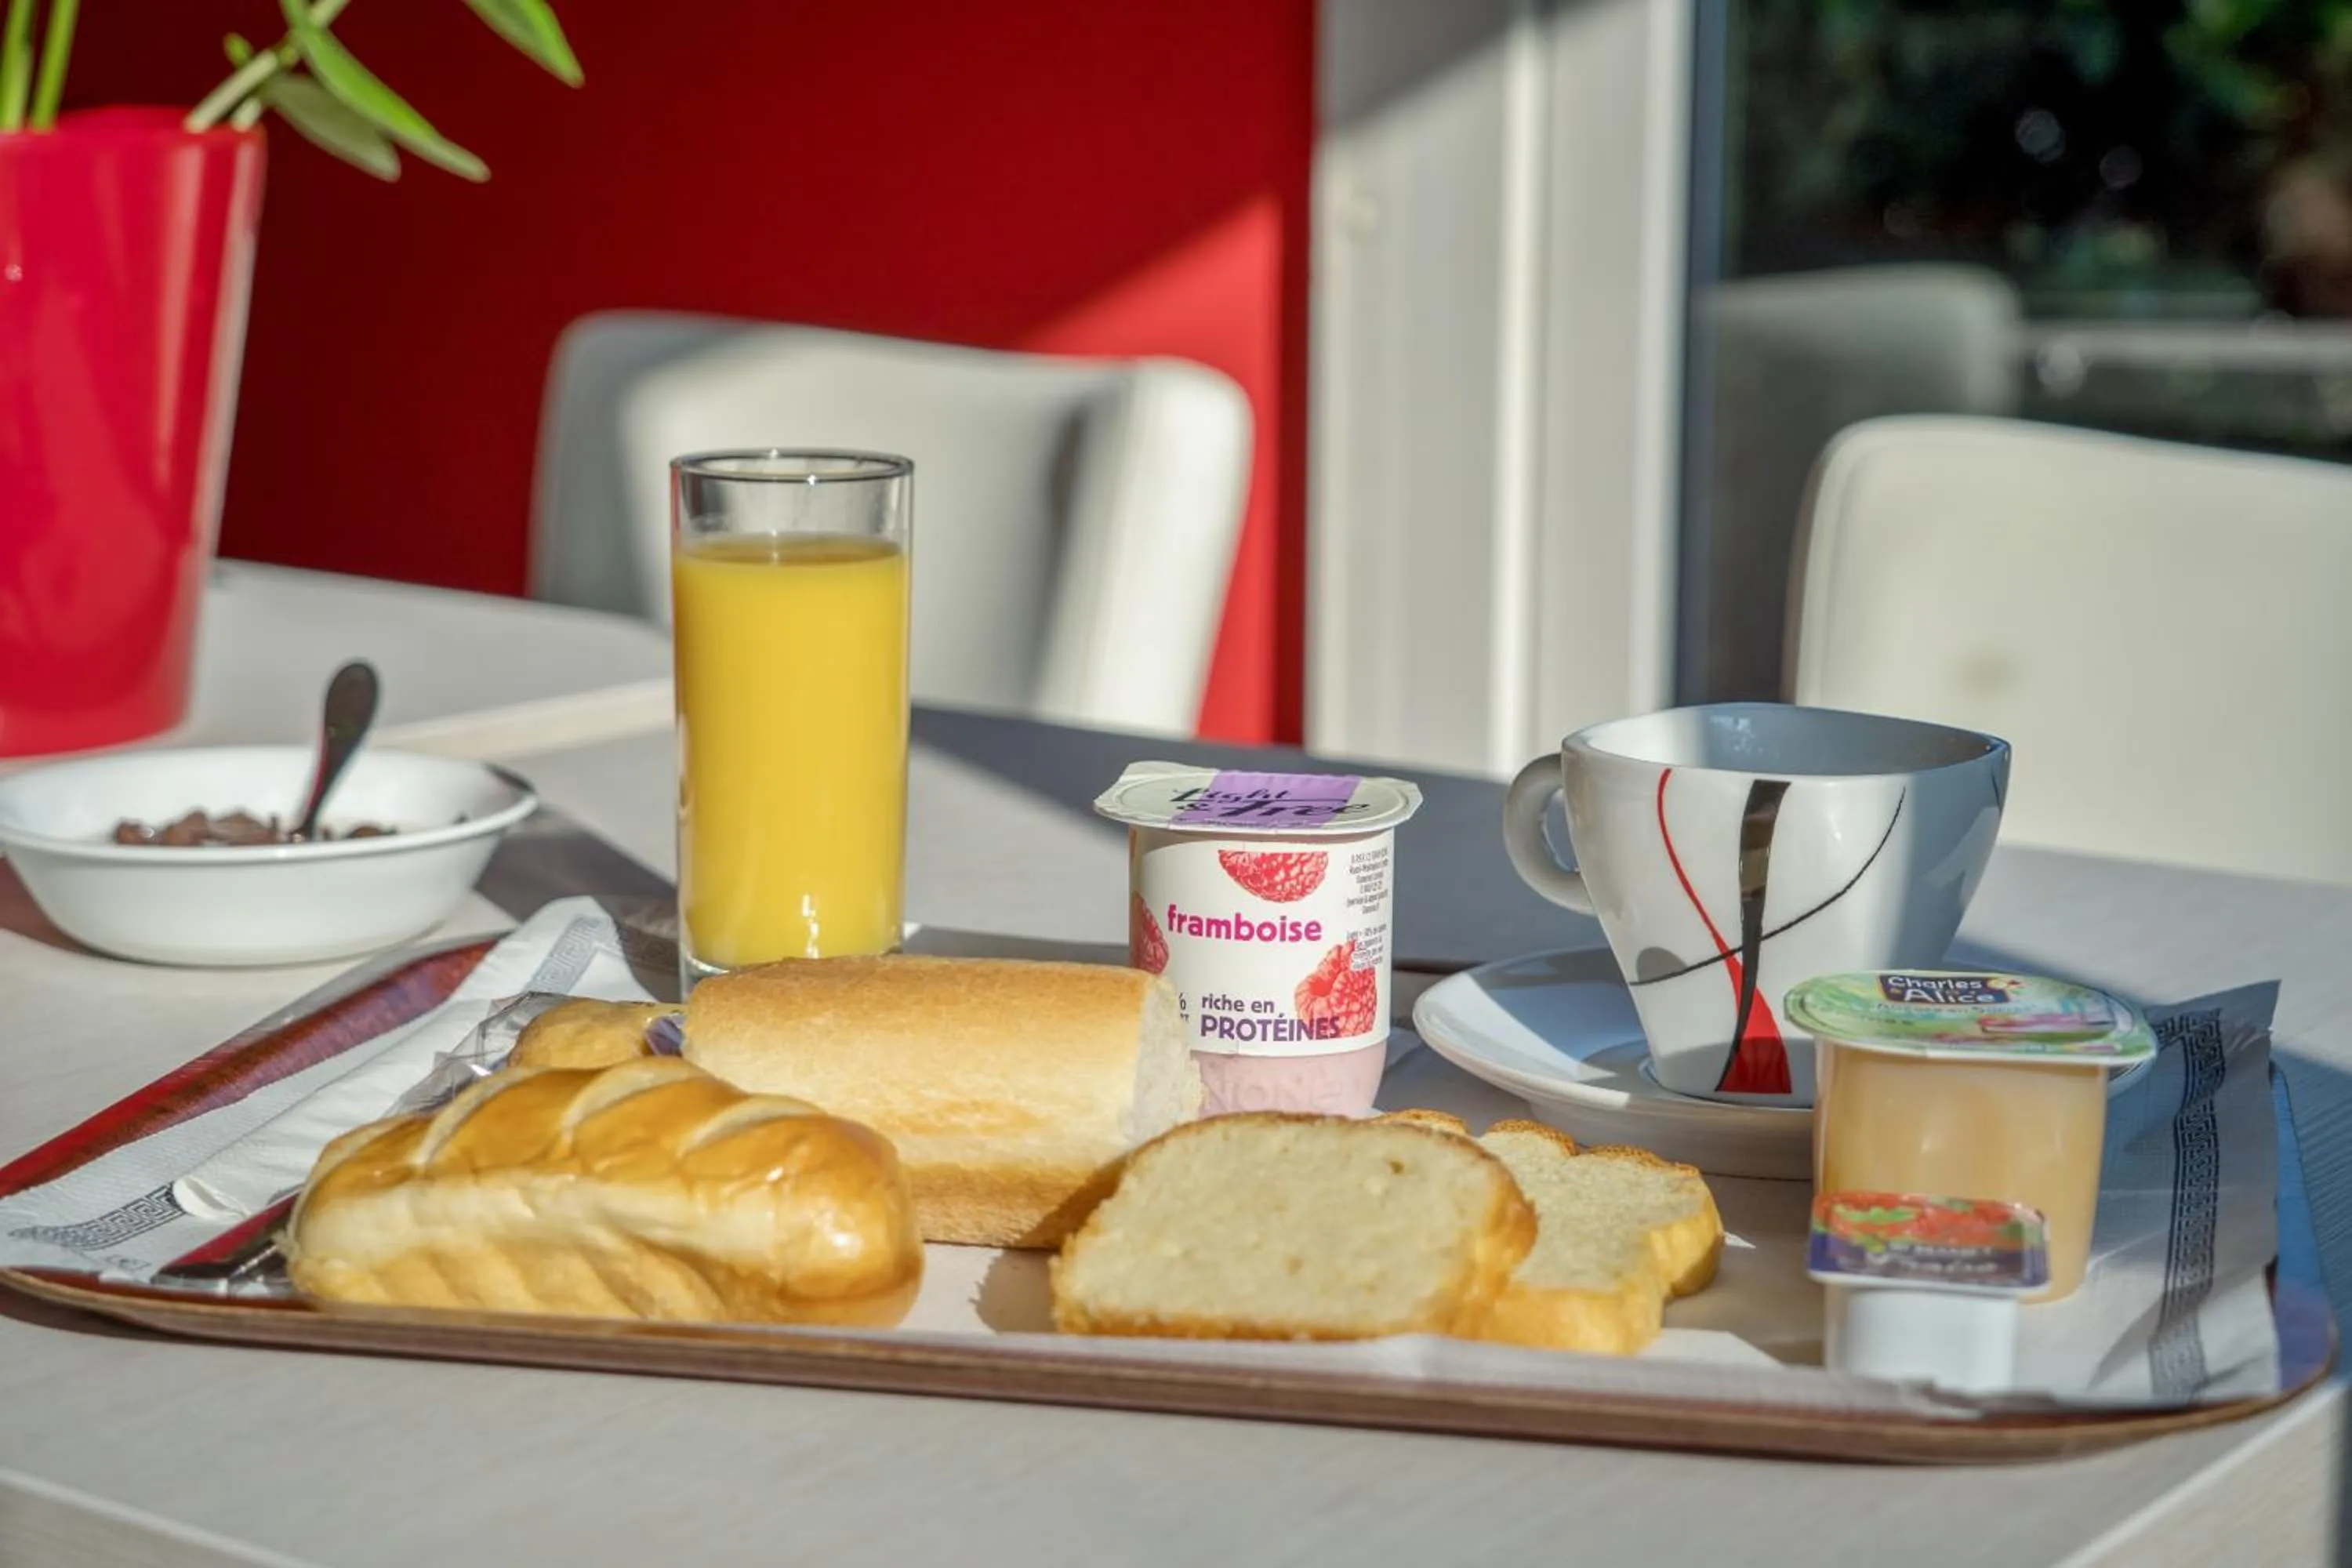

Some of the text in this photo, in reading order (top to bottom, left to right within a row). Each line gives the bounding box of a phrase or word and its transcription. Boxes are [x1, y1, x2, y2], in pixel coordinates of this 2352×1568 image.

[1171, 788, 1292, 803] Light
[1167, 904, 1322, 942] framboise
[1888, 976, 1983, 989] Charles
[1201, 993, 1275, 1014] riche en
[1904, 989, 1994, 1004] Alice
[1200, 1012, 1340, 1043] PROTÉINES
